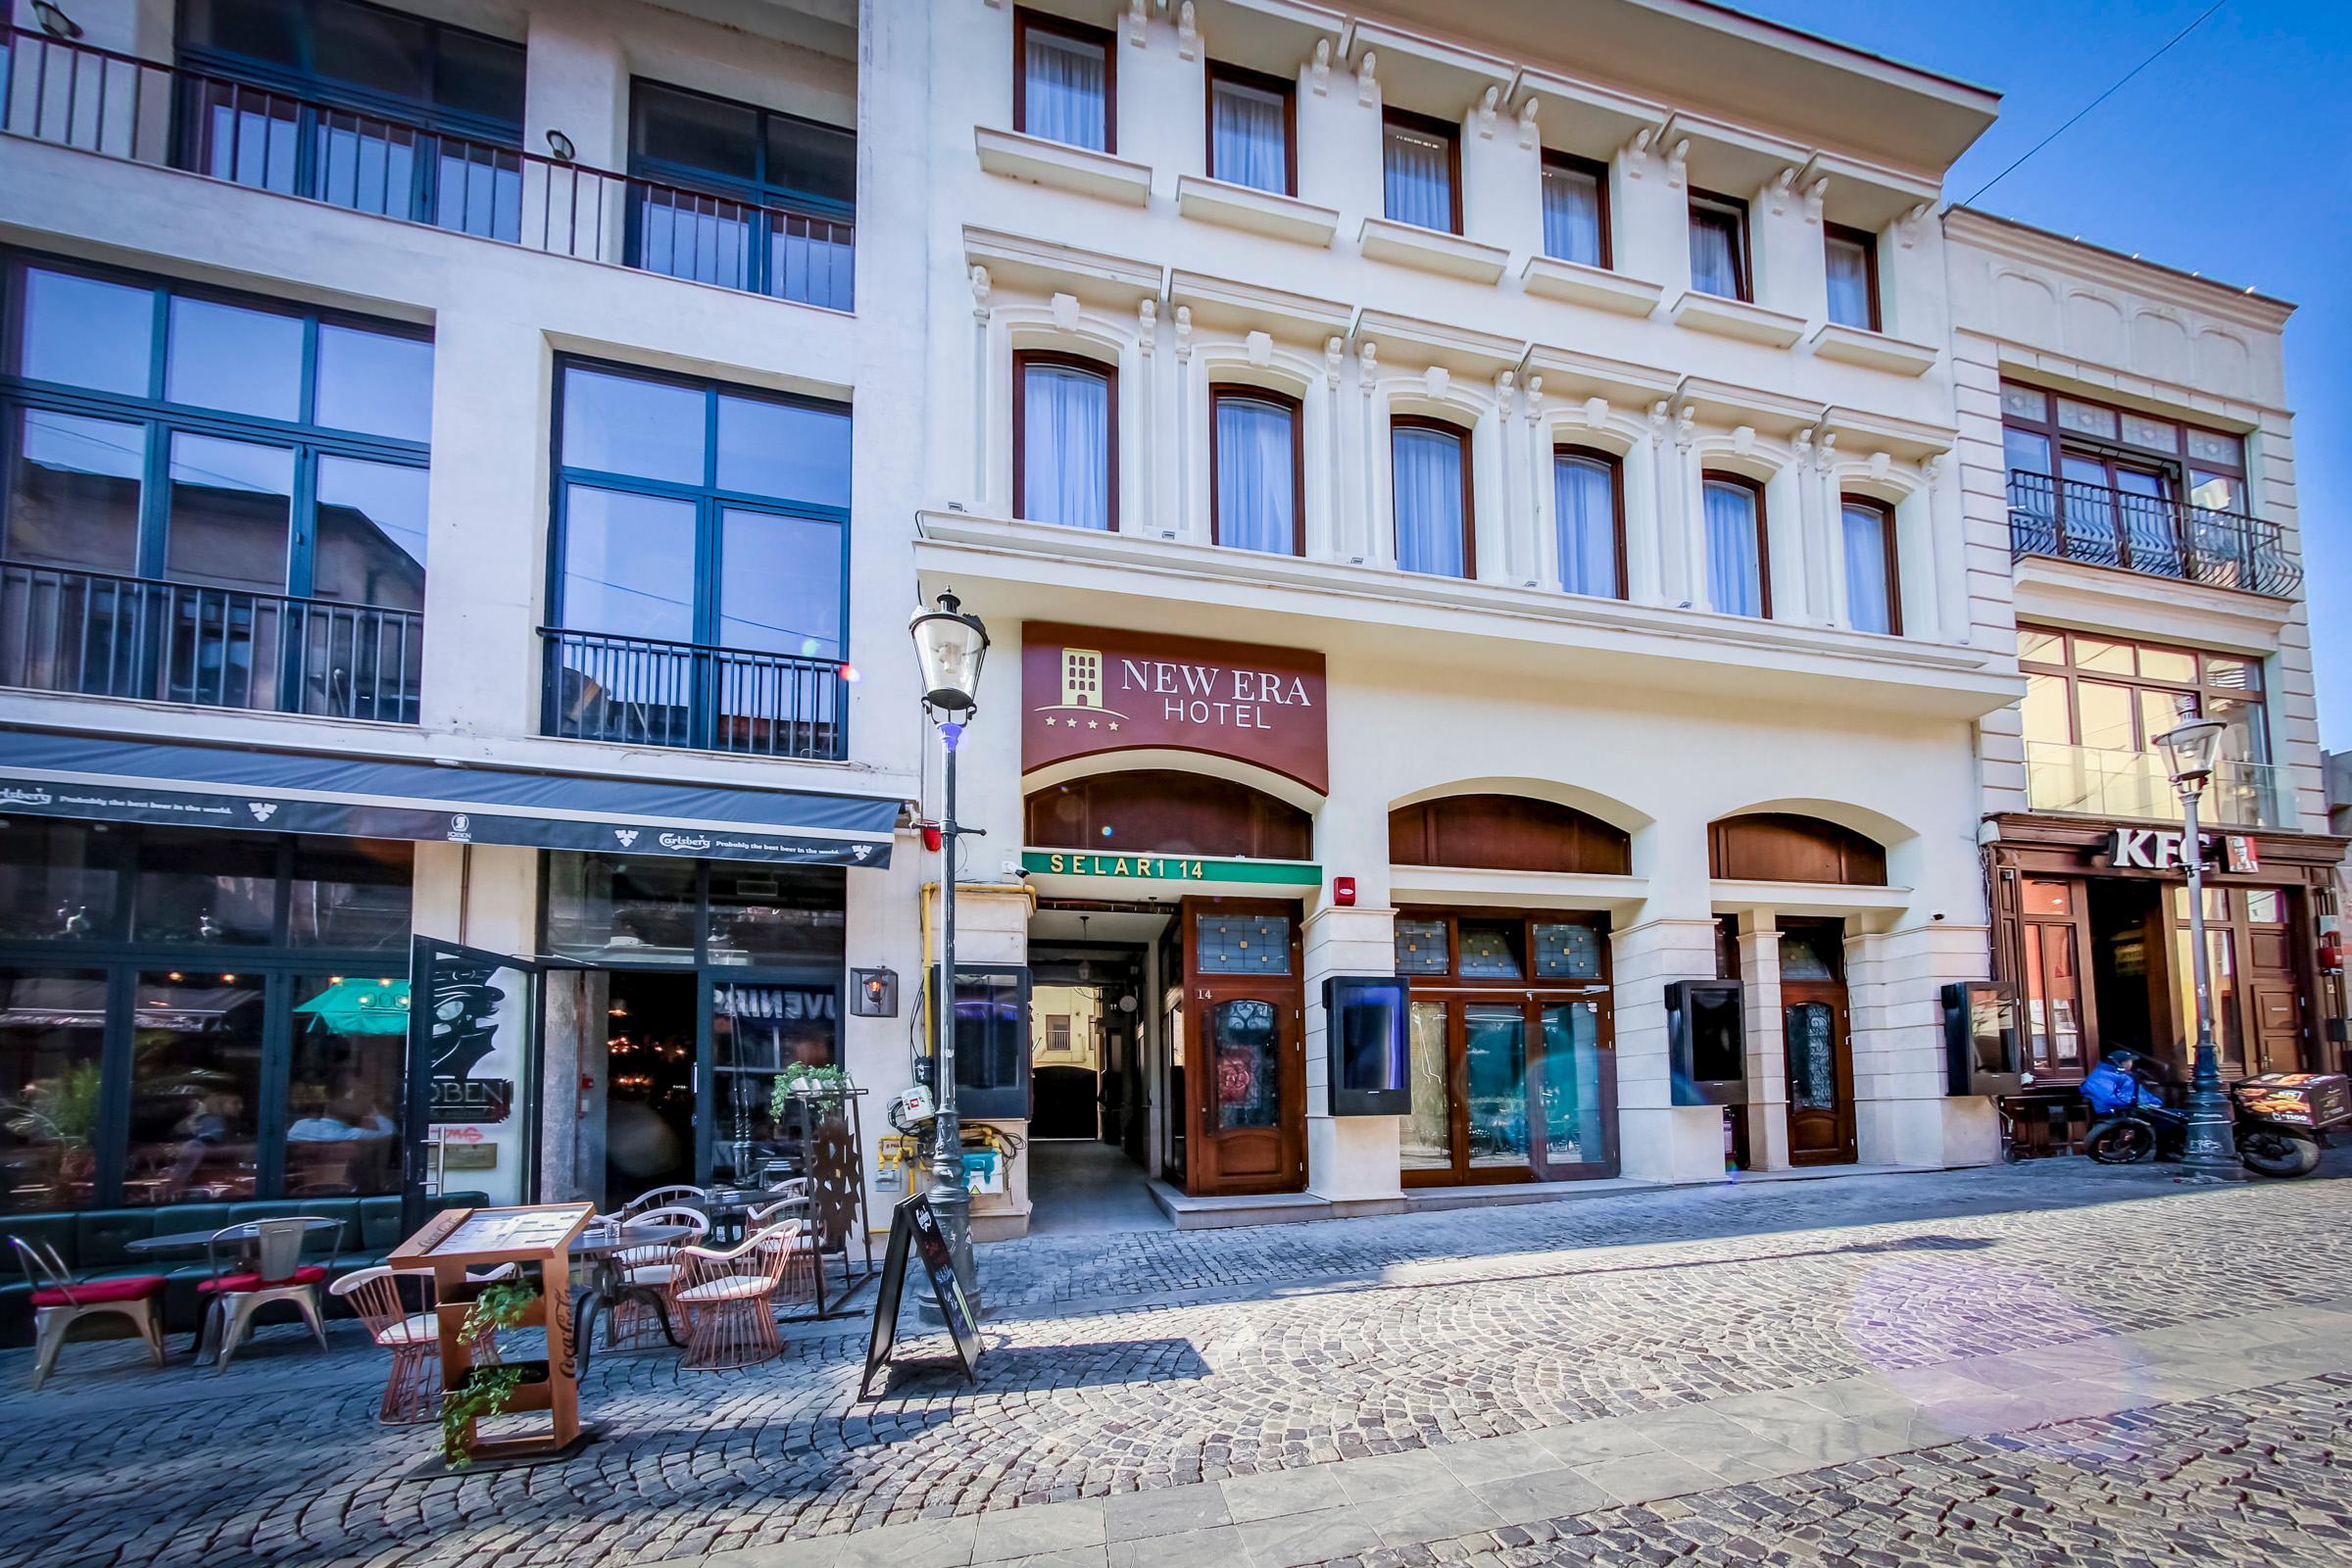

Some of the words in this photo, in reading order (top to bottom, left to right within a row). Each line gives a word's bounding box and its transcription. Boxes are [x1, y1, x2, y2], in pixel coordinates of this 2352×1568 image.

[1121, 659, 1219, 698] NEW
[1231, 669, 1312, 707] ERA
[1164, 698, 1271, 730] HOTEL
[0, 788, 52, 805] rlsberg
[659, 832, 710, 851] Carlsberg
[2113, 828, 2211, 870] KFC
[1051, 854, 1164, 877] SELARI
[1179, 860, 1203, 879] 14
[1197, 990, 1212, 1000] 14
[429, 1082, 505, 1105] OBEN
